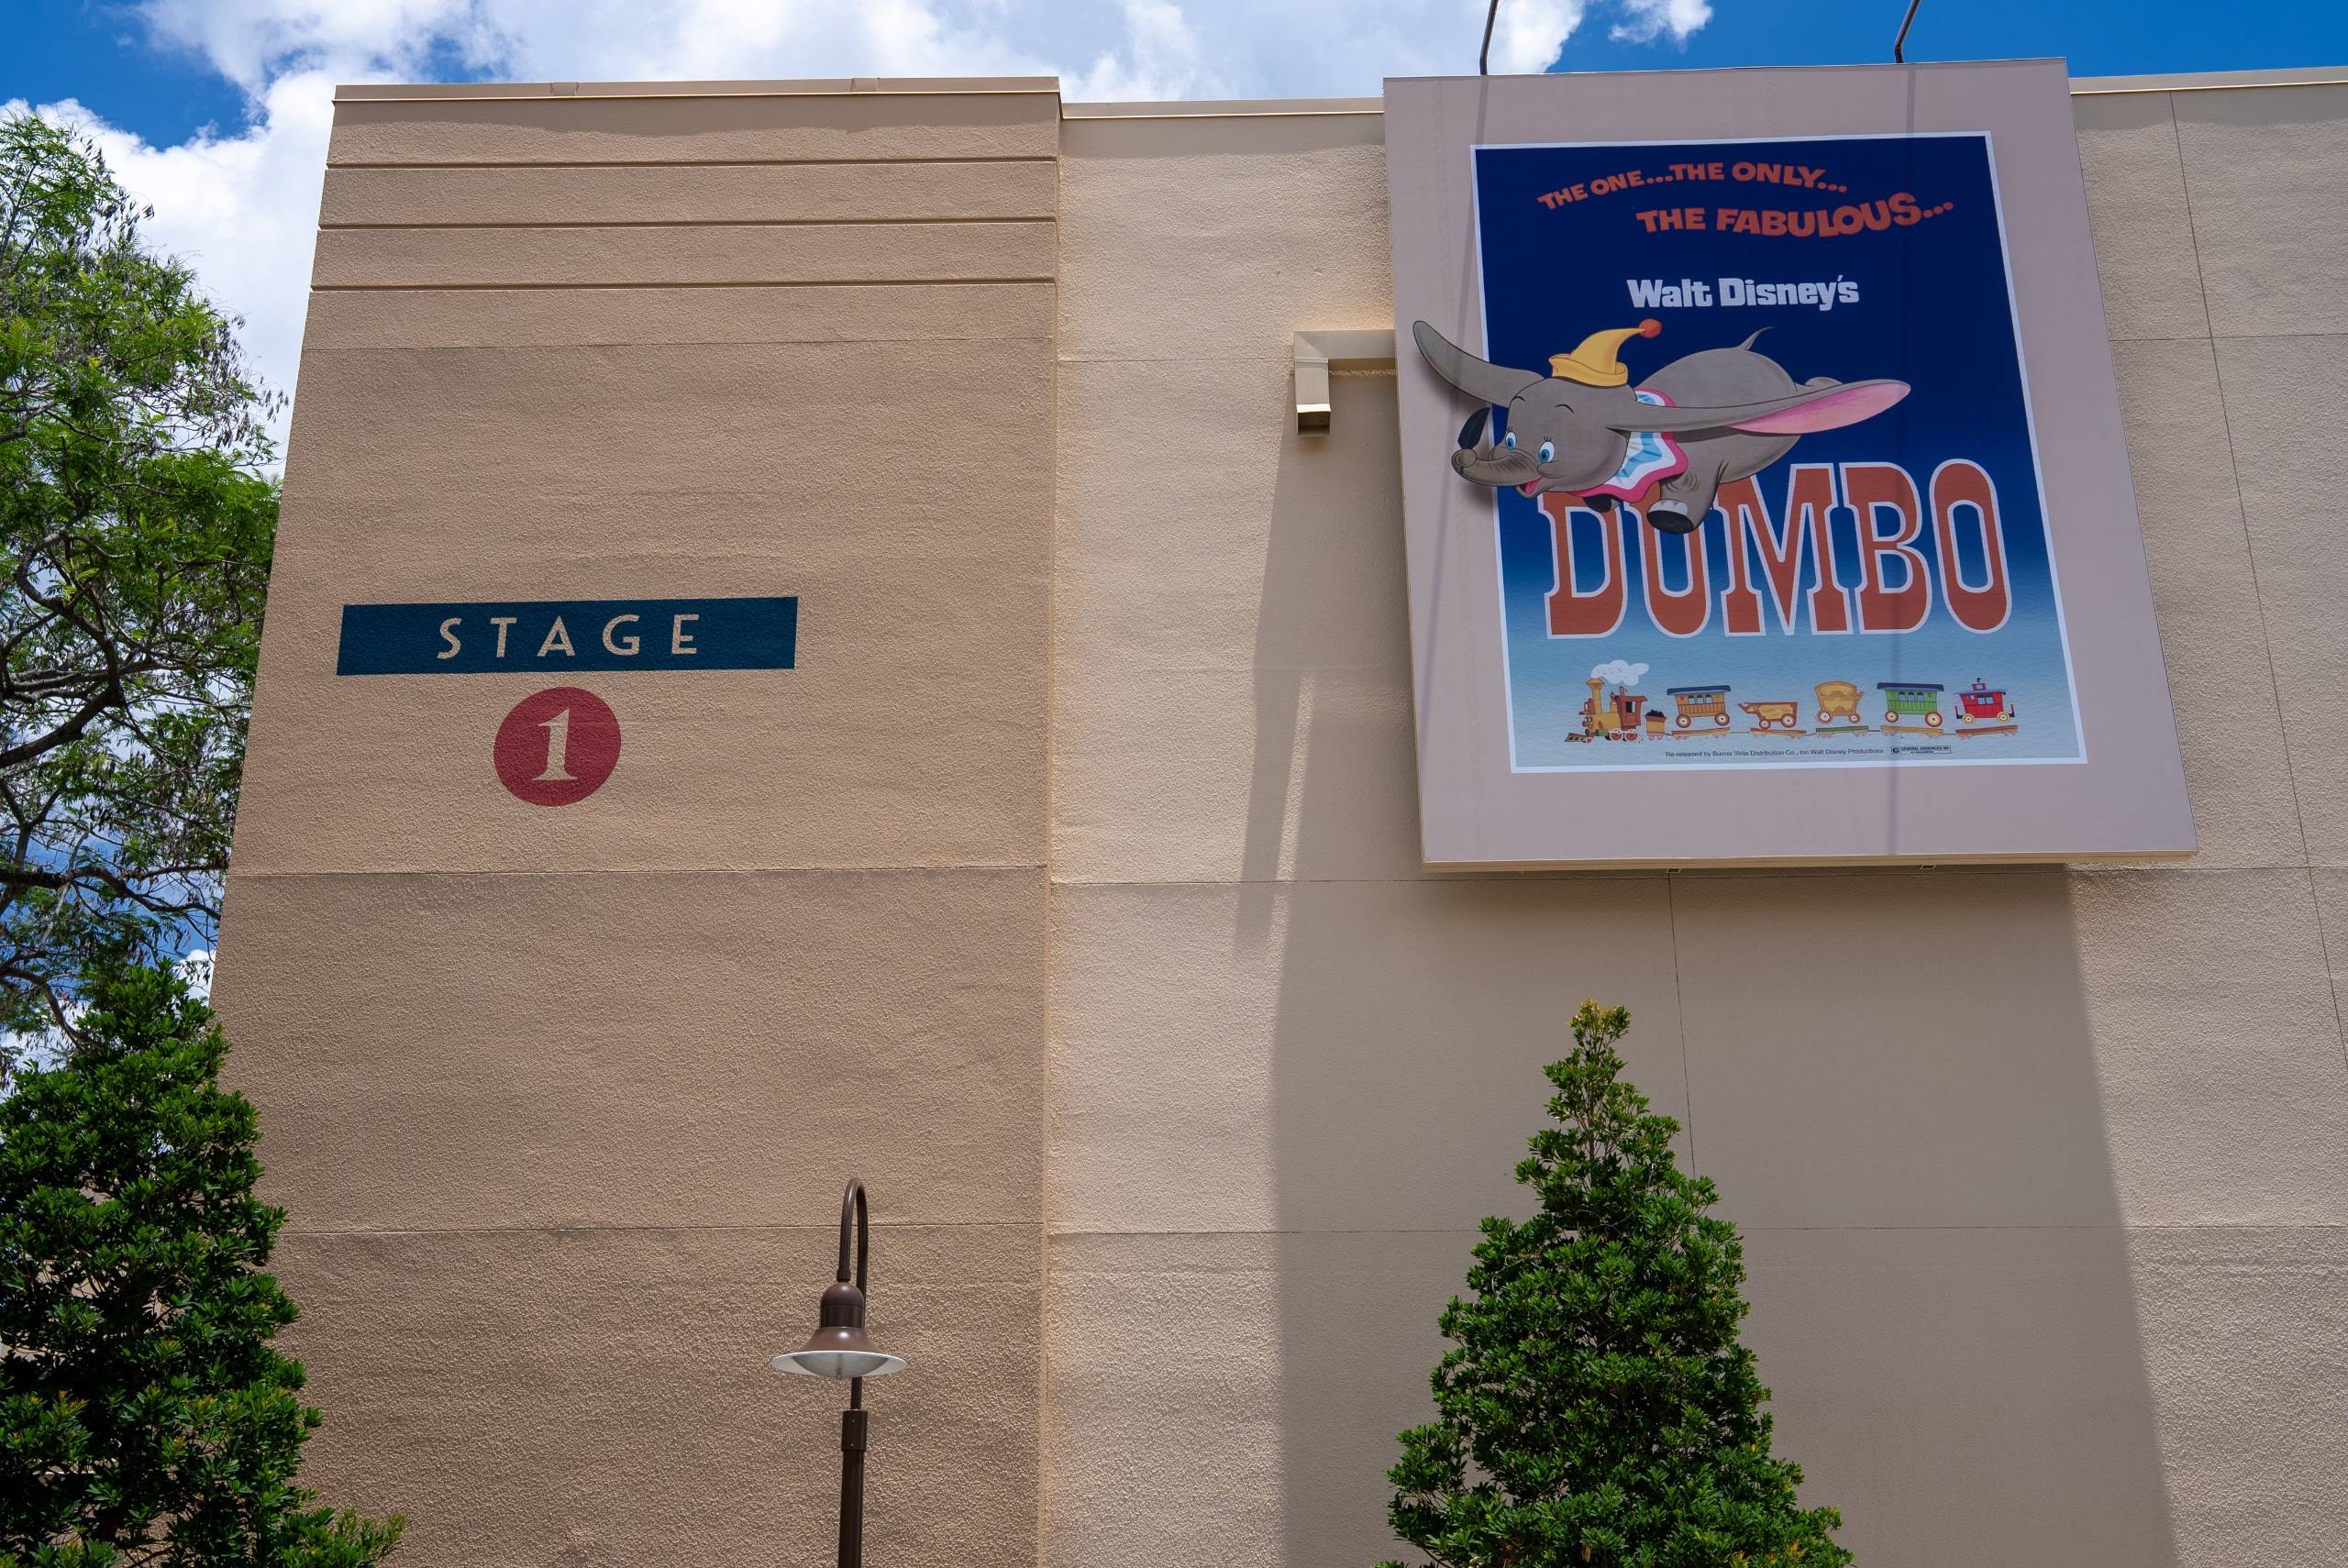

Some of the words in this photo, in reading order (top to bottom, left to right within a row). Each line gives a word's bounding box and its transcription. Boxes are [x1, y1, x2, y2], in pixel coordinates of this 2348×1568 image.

[1536, 183, 1589, 210] THE
[1732, 161, 1848, 193] ONLY...
[1636, 207, 1706, 233] THE
[1716, 192, 1955, 237] FABULOUS...
[1626, 279, 1713, 308] Walt
[1719, 275, 1860, 311] Disney's
[1537, 458, 2012, 639] DUMBO
[437, 613, 700, 659] STAGE
[531, 708, 579, 781] 1
